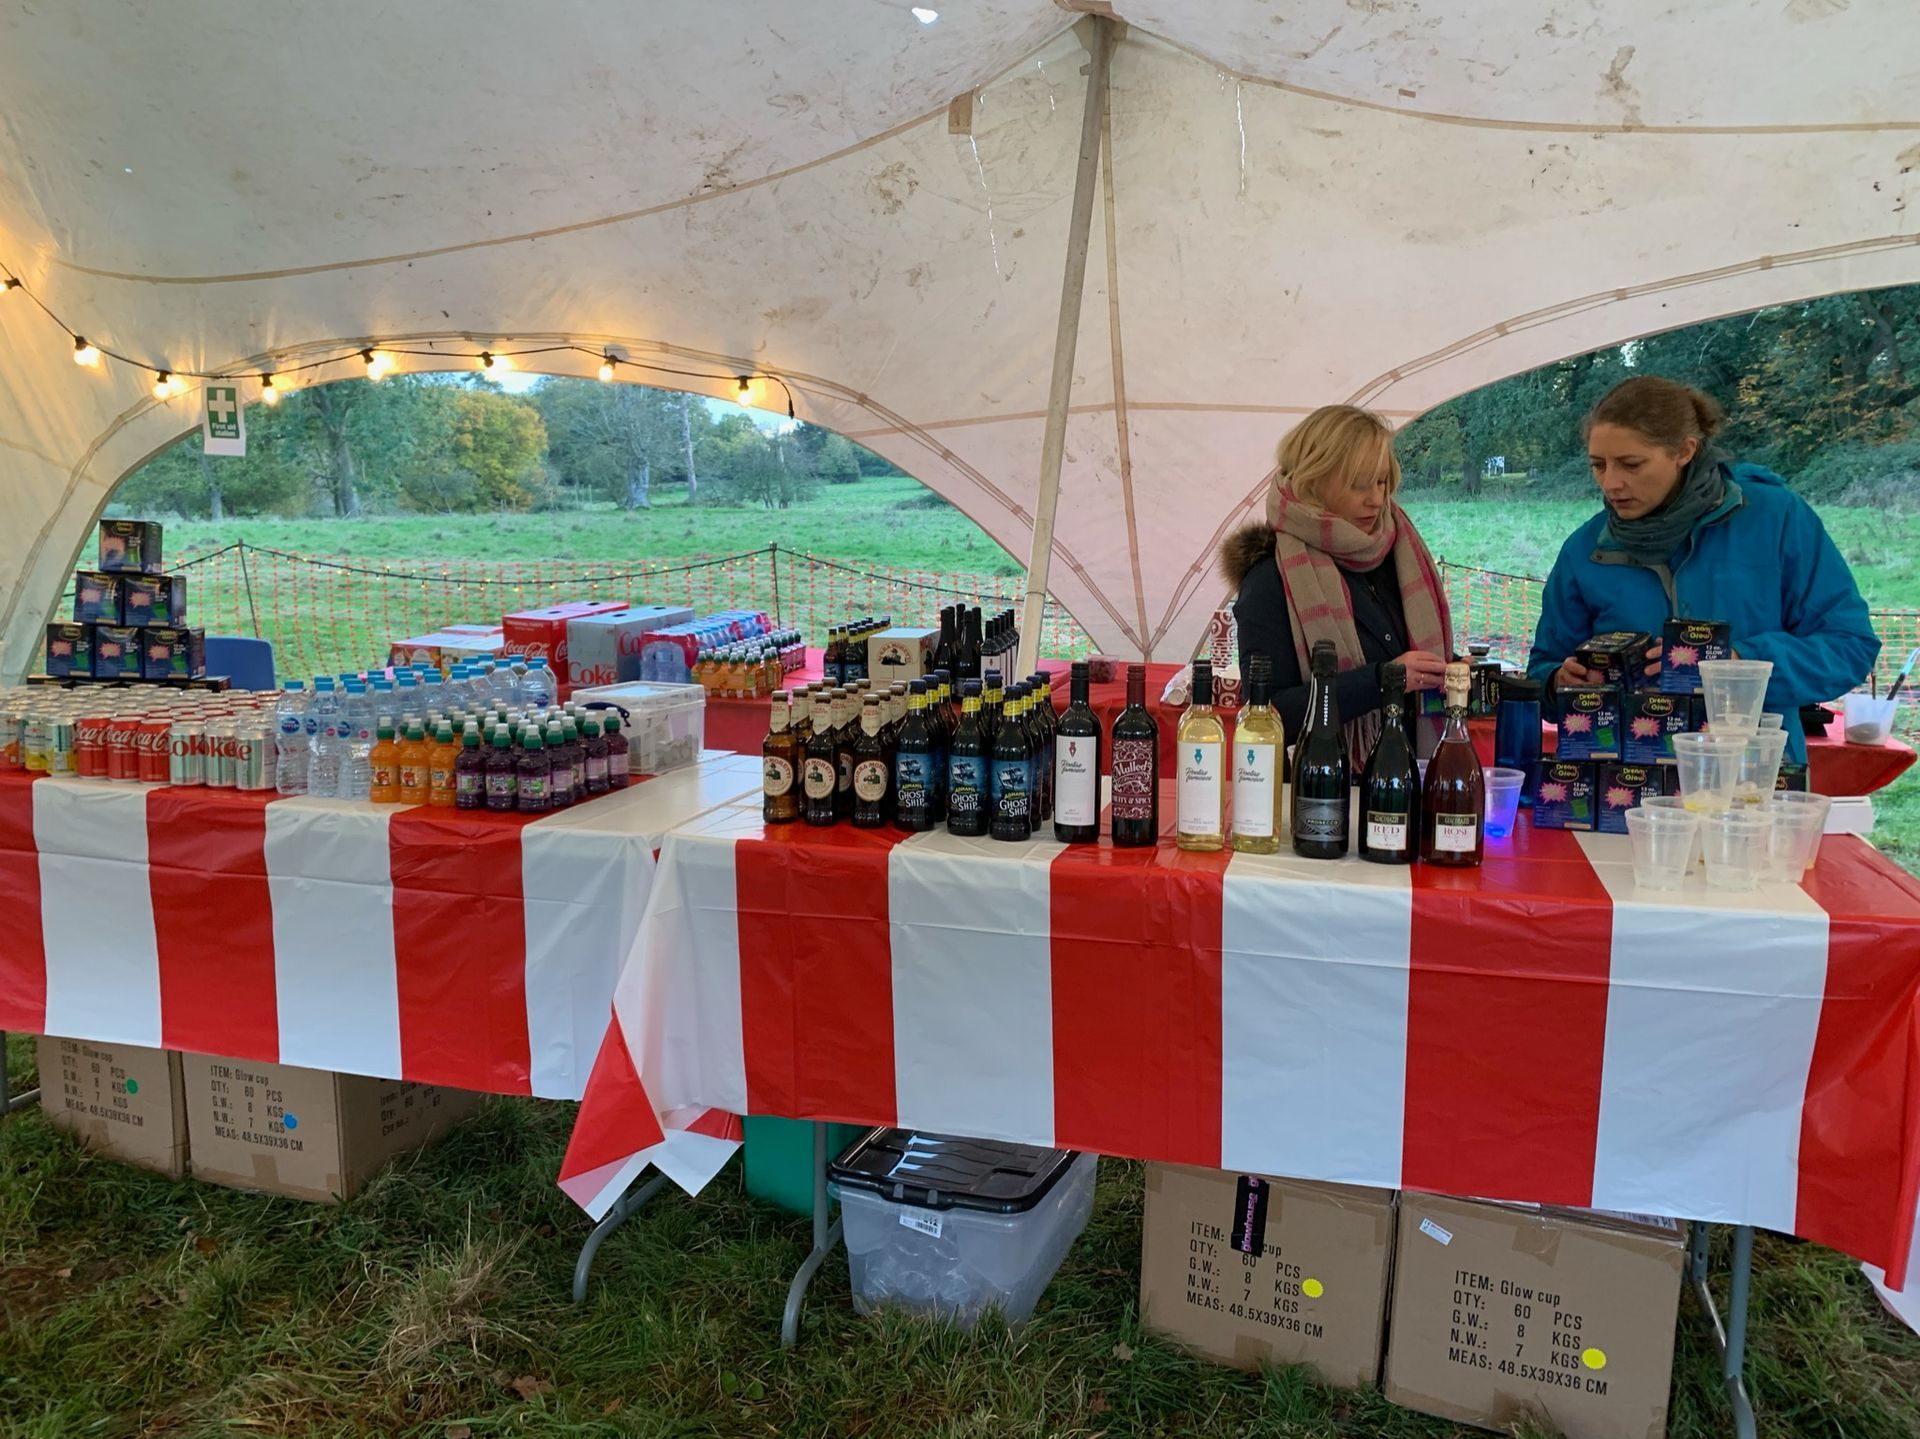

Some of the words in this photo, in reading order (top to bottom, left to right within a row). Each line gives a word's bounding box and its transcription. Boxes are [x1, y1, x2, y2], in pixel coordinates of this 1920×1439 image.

[568, 660, 618, 686] Coke
[898, 789, 926, 801] GHOST
[951, 793, 979, 804] GHOST
[999, 798, 1028, 810] GHOST
[1374, 825, 1400, 835] RED
[110, 1066, 125, 1080] PCS
[210, 1065, 233, 1080] ITEM:
[235, 1068, 254, 1082] Glow
[256, 1075, 268, 1087] cup
[112, 1081, 127, 1095] KGS
[211, 1080, 230, 1094] QTY:
[244, 1086, 255, 1098] 60
[266, 1090, 283, 1103] PCS
[113, 1096, 128, 1109] KGS
[212, 1095, 232, 1110] G.W.:
[248, 1102, 252, 1113] 8
[267, 1105, 284, 1118] KGS
[132, 1114, 144, 1127] CM
[213, 1111, 234, 1125] N.W.:
[249, 1117, 254, 1128] 7
[268, 1121, 285, 1134] KGS
[215, 1126, 240, 1141] MEAS:
[242, 1131, 289, 1150] 48.5X39X36
[290, 1139, 304, 1152] CM
[1241, 1192, 1259, 1253] glowhouse
[1191, 1221, 1225, 1242] ITEM:
[1264, 1244, 1282, 1258] cup
[1190, 1239, 1217, 1258] QTY:
[1242, 1253, 1257, 1268] 60
[1276, 1262, 1301, 1279] PCS
[1189, 1256, 1220, 1276] G.W.:
[1244, 1272, 1252, 1284] 8
[1274, 1280, 1300, 1297] KGS
[1455, 1270, 1494, 1292] ITEM:
[1500, 1280, 1534, 1300] Glow
[1538, 1292, 1561, 1308] cup
[1188, 1274, 1220, 1294] N.W.:
[1244, 1289, 1251, 1301] 7
[1274, 1296, 1299, 1314] KGS
[1186, 1290, 1224, 1312] MEAS:
[1229, 1303, 1300, 1332] 48.5X39X36
[1304, 1322, 1324, 1338] CM
[1454, 1290, 1485, 1310] QTY:
[1514, 1304, 1532, 1319] 60
[1554, 1312, 1583, 1330] PCS
[1452, 1309, 1488, 1330] G.W.:
[1516, 1324, 1525, 1338] 8
[1552, 1331, 1581, 1350] KGS
[1450, 1328, 1487, 1350] N.W.:
[1515, 1344, 1524, 1358] 7
[1550, 1350, 1580, 1370] KGS
[1448, 1348, 1492, 1370] MEAS:
[1498, 1360, 1582, 1390] 48.5X39X36
[1586, 1378, 1608, 1396] CM
